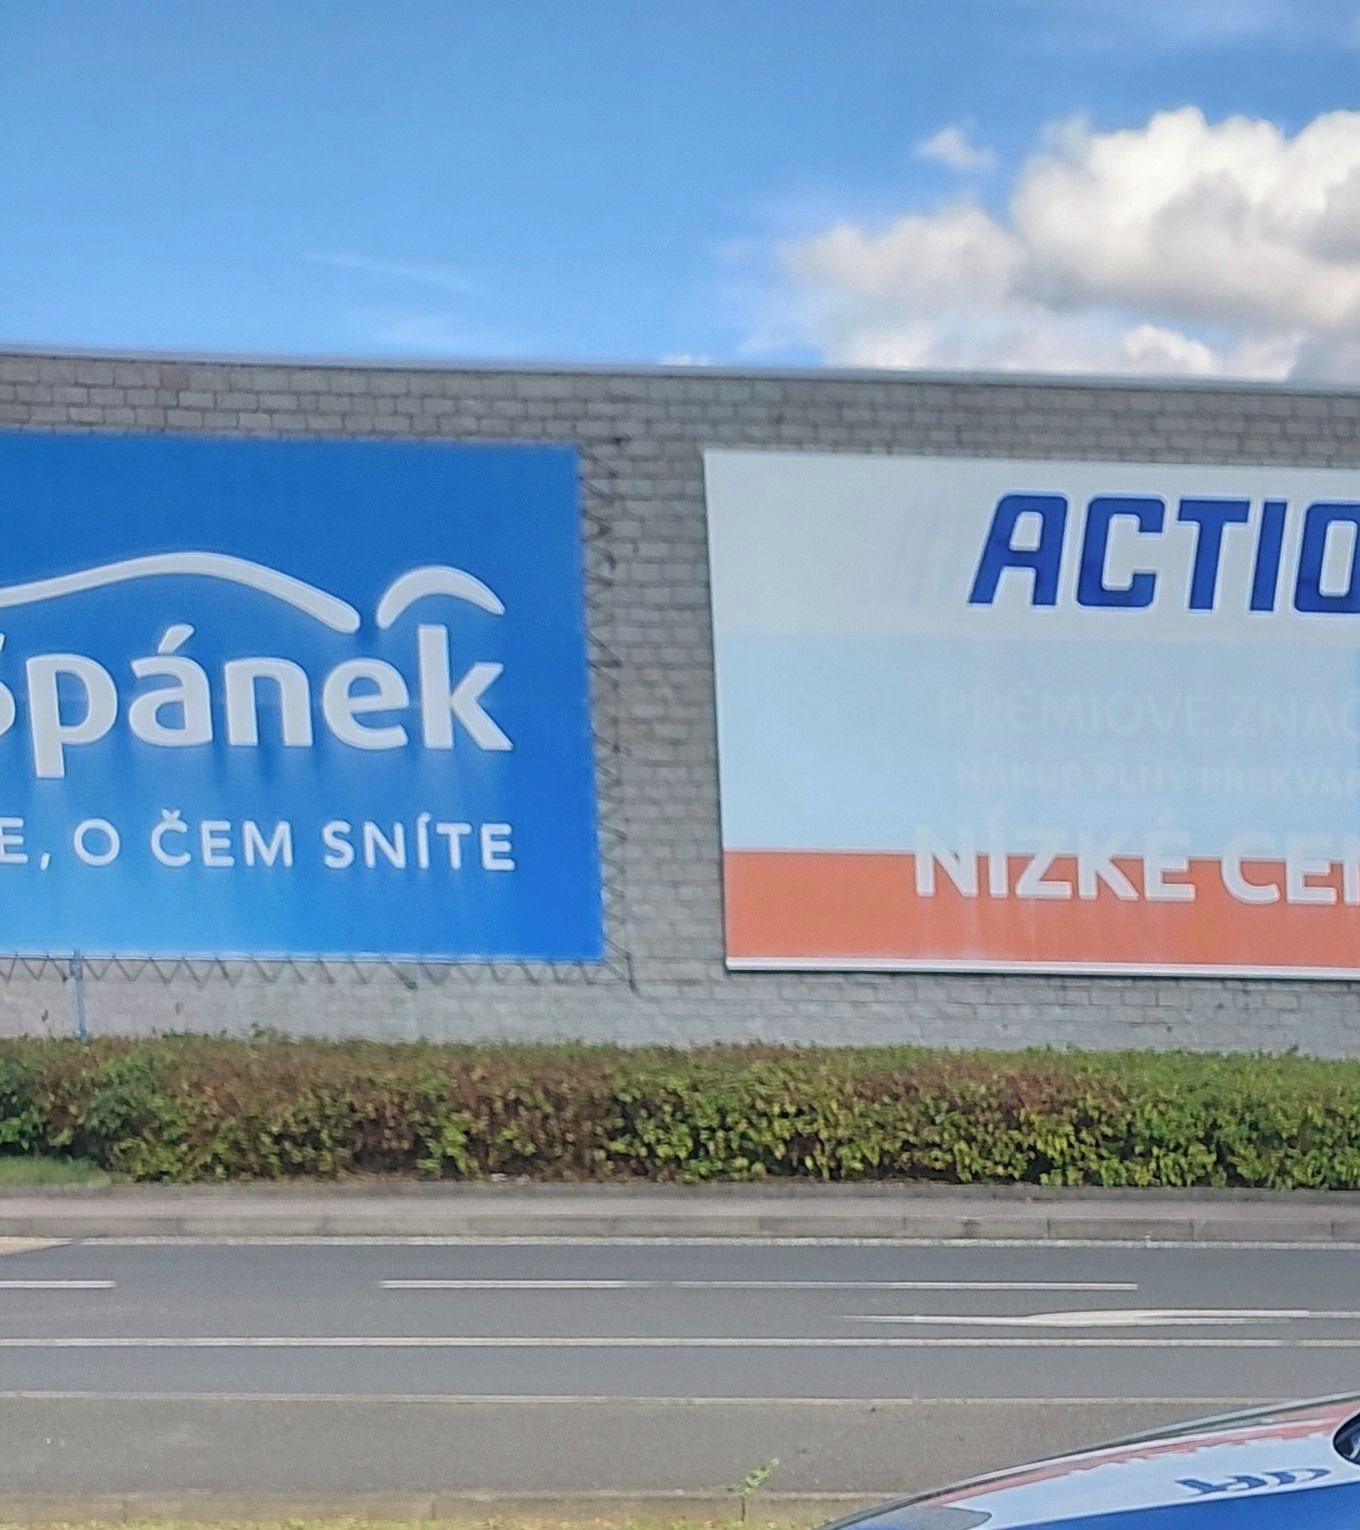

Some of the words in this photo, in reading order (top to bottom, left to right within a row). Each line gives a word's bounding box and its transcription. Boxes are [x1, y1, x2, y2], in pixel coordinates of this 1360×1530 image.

[937, 682, 1214, 737] PRÉMIOVÉ
[956, 755, 1081, 792] NÁKUP
[1094, 758, 1187, 795] PLNÝ
[73, 818, 121, 867] O
[151, 808, 294, 868] ČEM
[323, 812, 517, 871] SNÍTE
[914, 806, 1197, 901] NÍZKÉ
